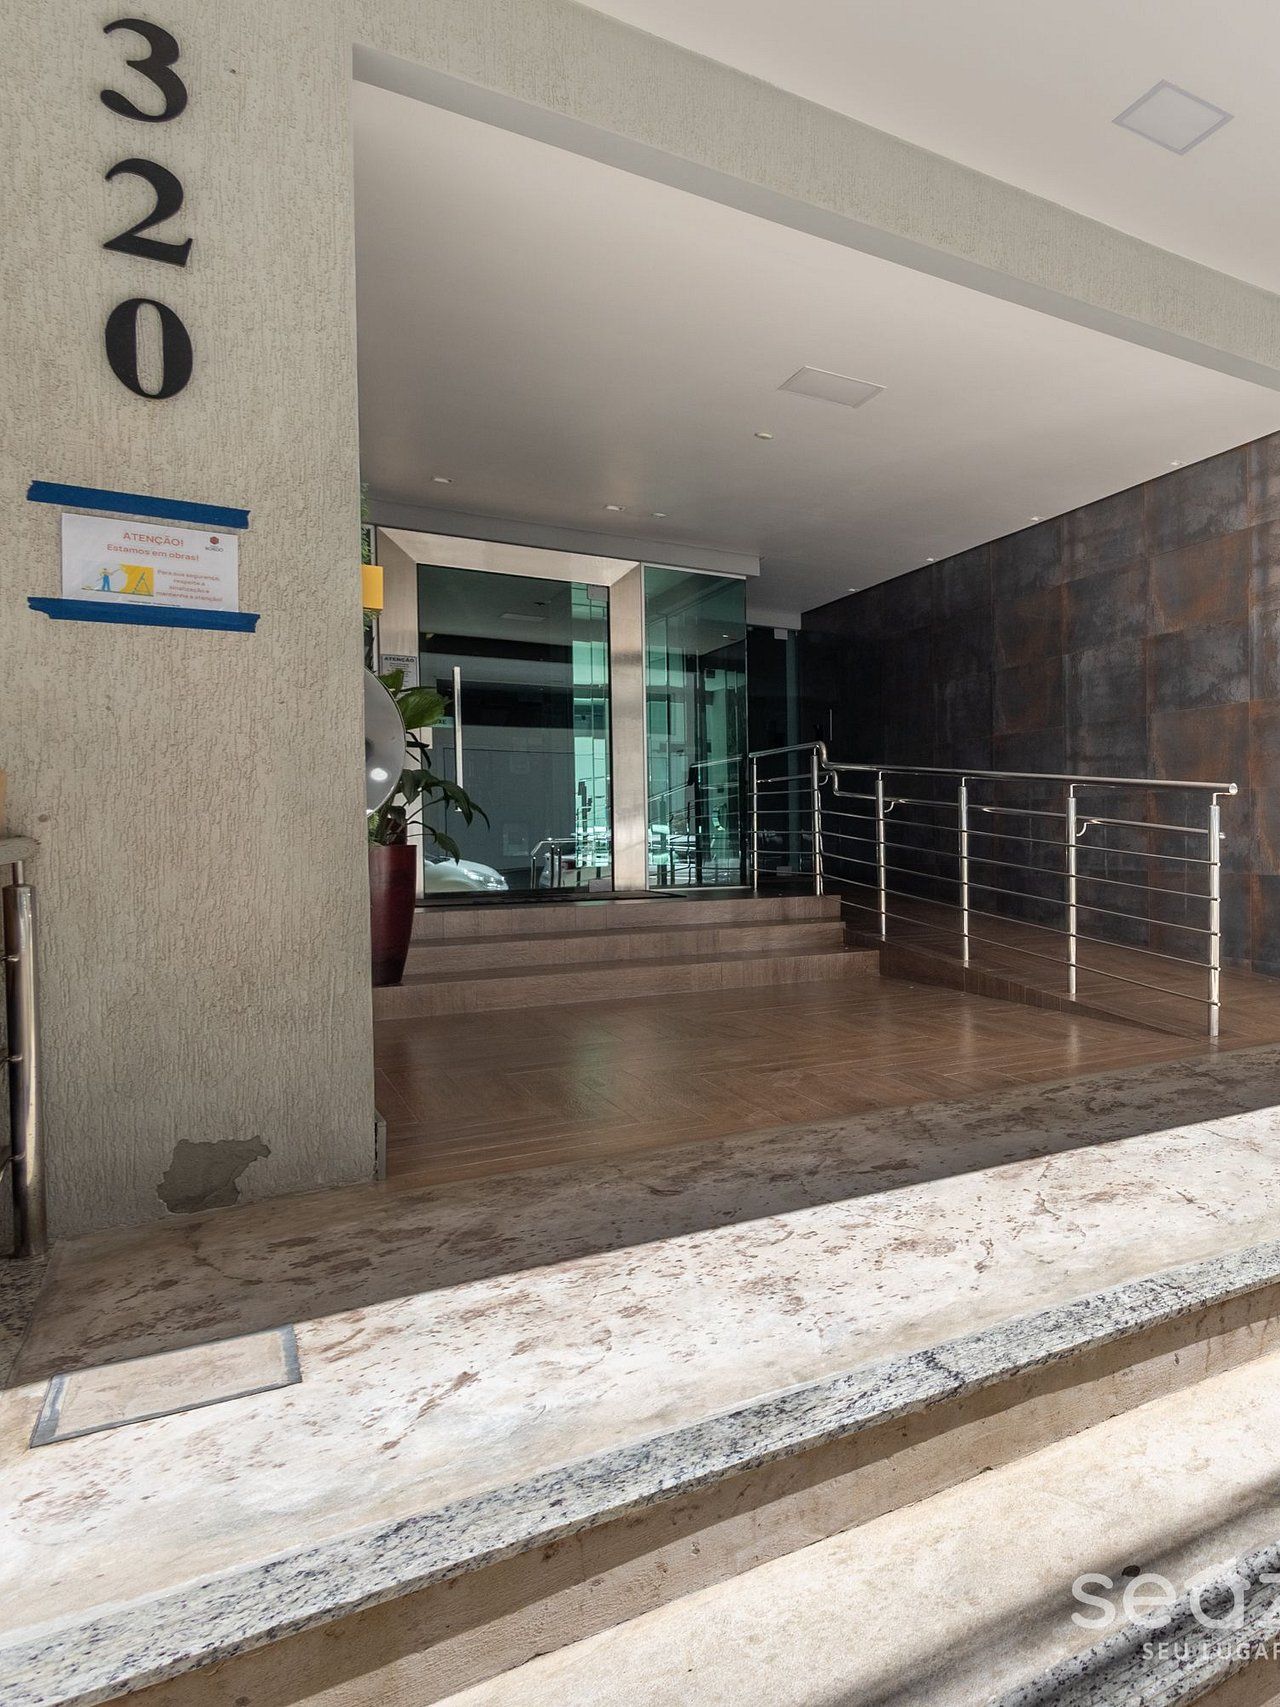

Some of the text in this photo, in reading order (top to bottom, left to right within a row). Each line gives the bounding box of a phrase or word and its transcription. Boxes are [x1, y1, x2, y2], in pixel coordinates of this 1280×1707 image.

[100, 18, 194, 400] 320
[122, 532, 184, 547] ATENÇÃO!
[106, 543, 199, 562] Estamos em obras!
